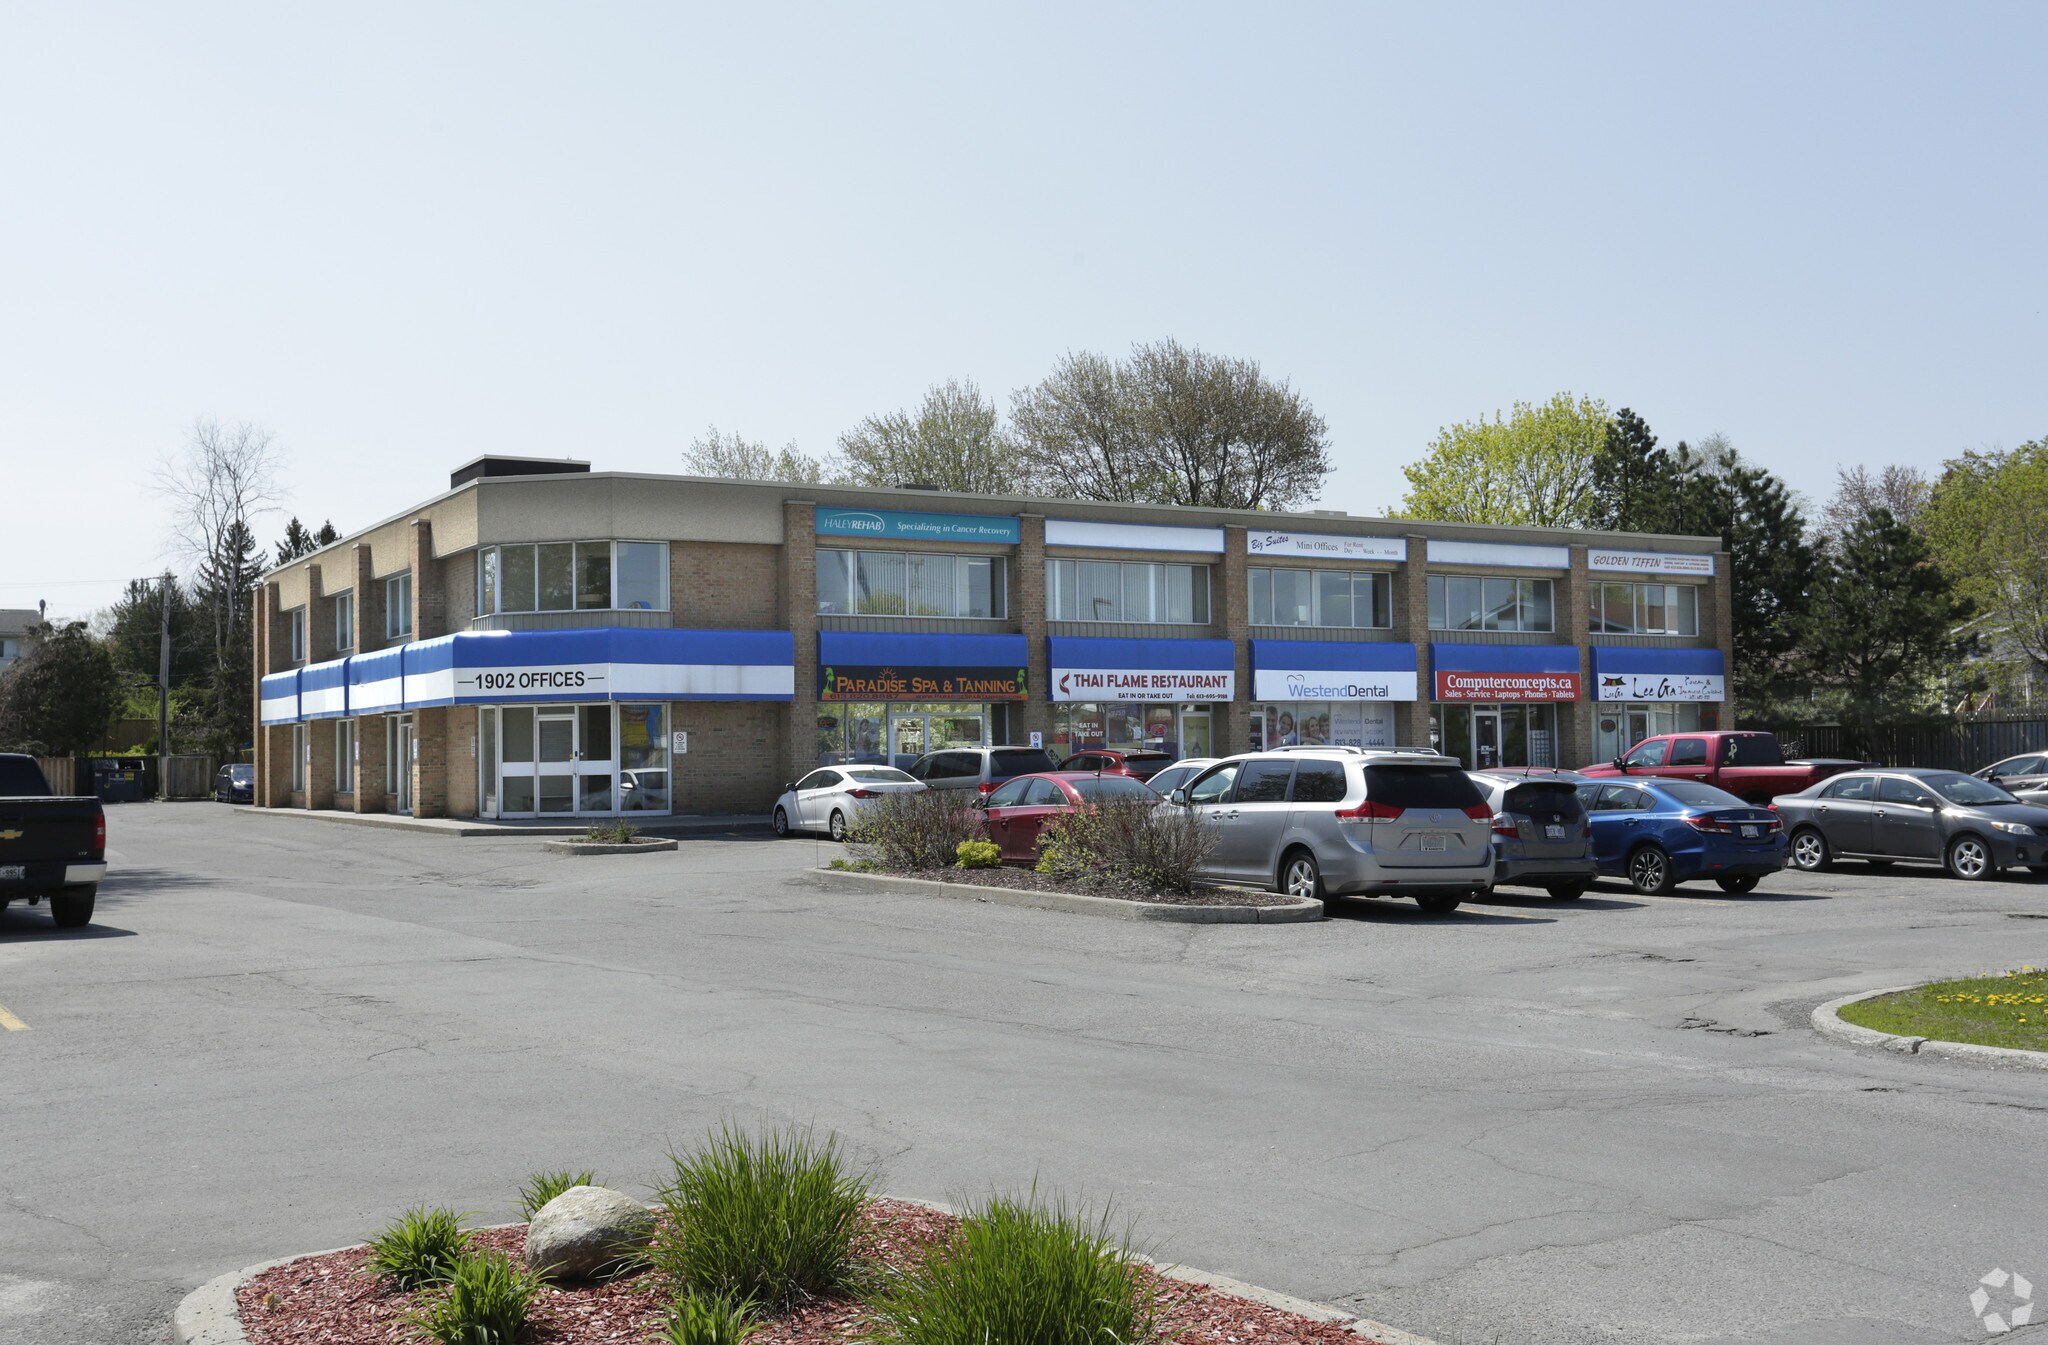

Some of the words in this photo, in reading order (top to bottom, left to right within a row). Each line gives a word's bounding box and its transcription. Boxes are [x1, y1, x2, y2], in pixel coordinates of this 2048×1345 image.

[897, 522, 941, 534] Specializing
[951, 525, 977, 534] Cancer
[978, 526, 1011, 537] Recovery
[1265, 535, 1289, 547] Suites
[1296, 541, 1313, 550] Mini
[1314, 542, 1339, 551] Offices
[1593, 556, 1630, 566] GOLDEN
[1631, 557, 1662, 568] TIFFIN
[475, 673, 515, 690] 1902
[519, 671, 585, 688] OFFICES
[837, 677, 907, 693] PARADISE
[943, 680, 953, 693] &
[956, 677, 1016, 693] TANNING
[1074, 674, 1104, 688] THAI
[1107, 674, 1148, 688] FLAME
[1151, 675, 1228, 689] RESTAURANT
[1447, 675, 1572, 691] Computerconcepts.ca
[1288, 684, 1389, 697] WestendDental
[1445, 690, 1462, 698] Sales
[1467, 690, 1491, 698] Service
[1495, 690, 1520, 699] Laptops
[1524, 690, 1548, 698] Phones
[1552, 690, 1575, 698] Tablets
